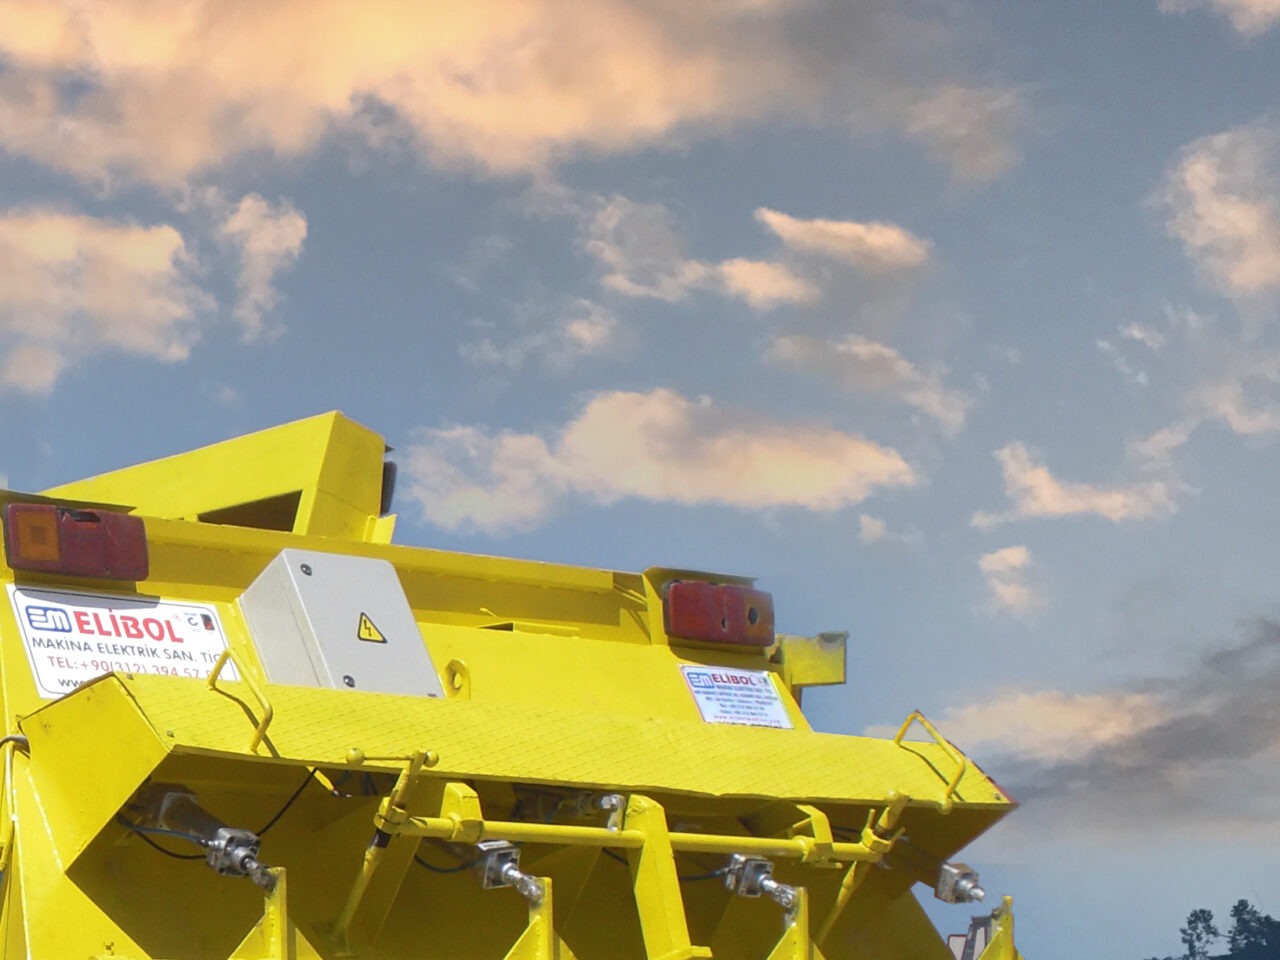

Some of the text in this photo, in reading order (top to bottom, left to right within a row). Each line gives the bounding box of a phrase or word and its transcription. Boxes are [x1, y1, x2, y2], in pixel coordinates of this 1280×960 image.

[73, 608, 184, 643] ELİBOL
[32, 637, 93, 652] MAKİNA
[96, 643, 160, 660] ELEKTRİK
[163, 648, 197, 662] SAN.
